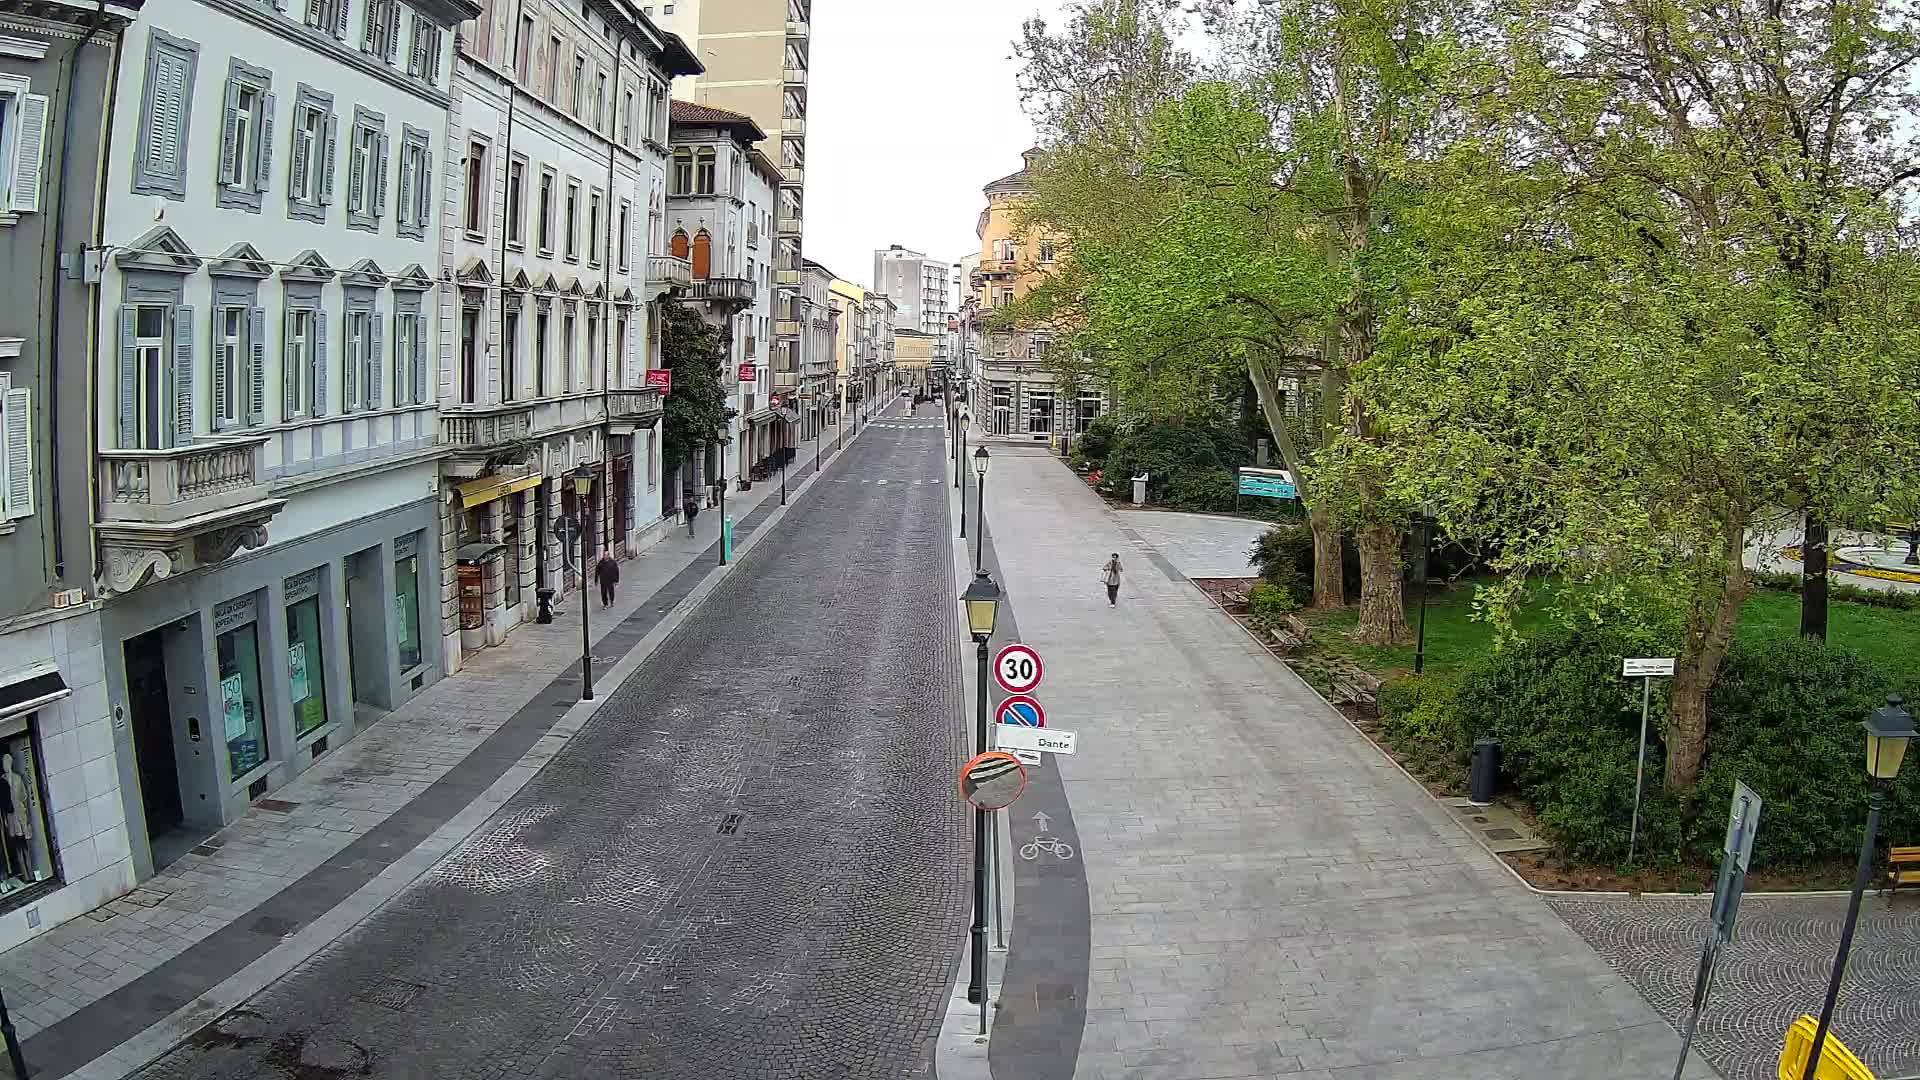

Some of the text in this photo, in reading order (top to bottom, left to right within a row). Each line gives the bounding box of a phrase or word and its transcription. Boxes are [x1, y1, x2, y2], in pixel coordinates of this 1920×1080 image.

[1006, 659, 1032, 680] 30
[221, 677, 240, 700] 130
[1038, 738, 1070, 749] Dante
